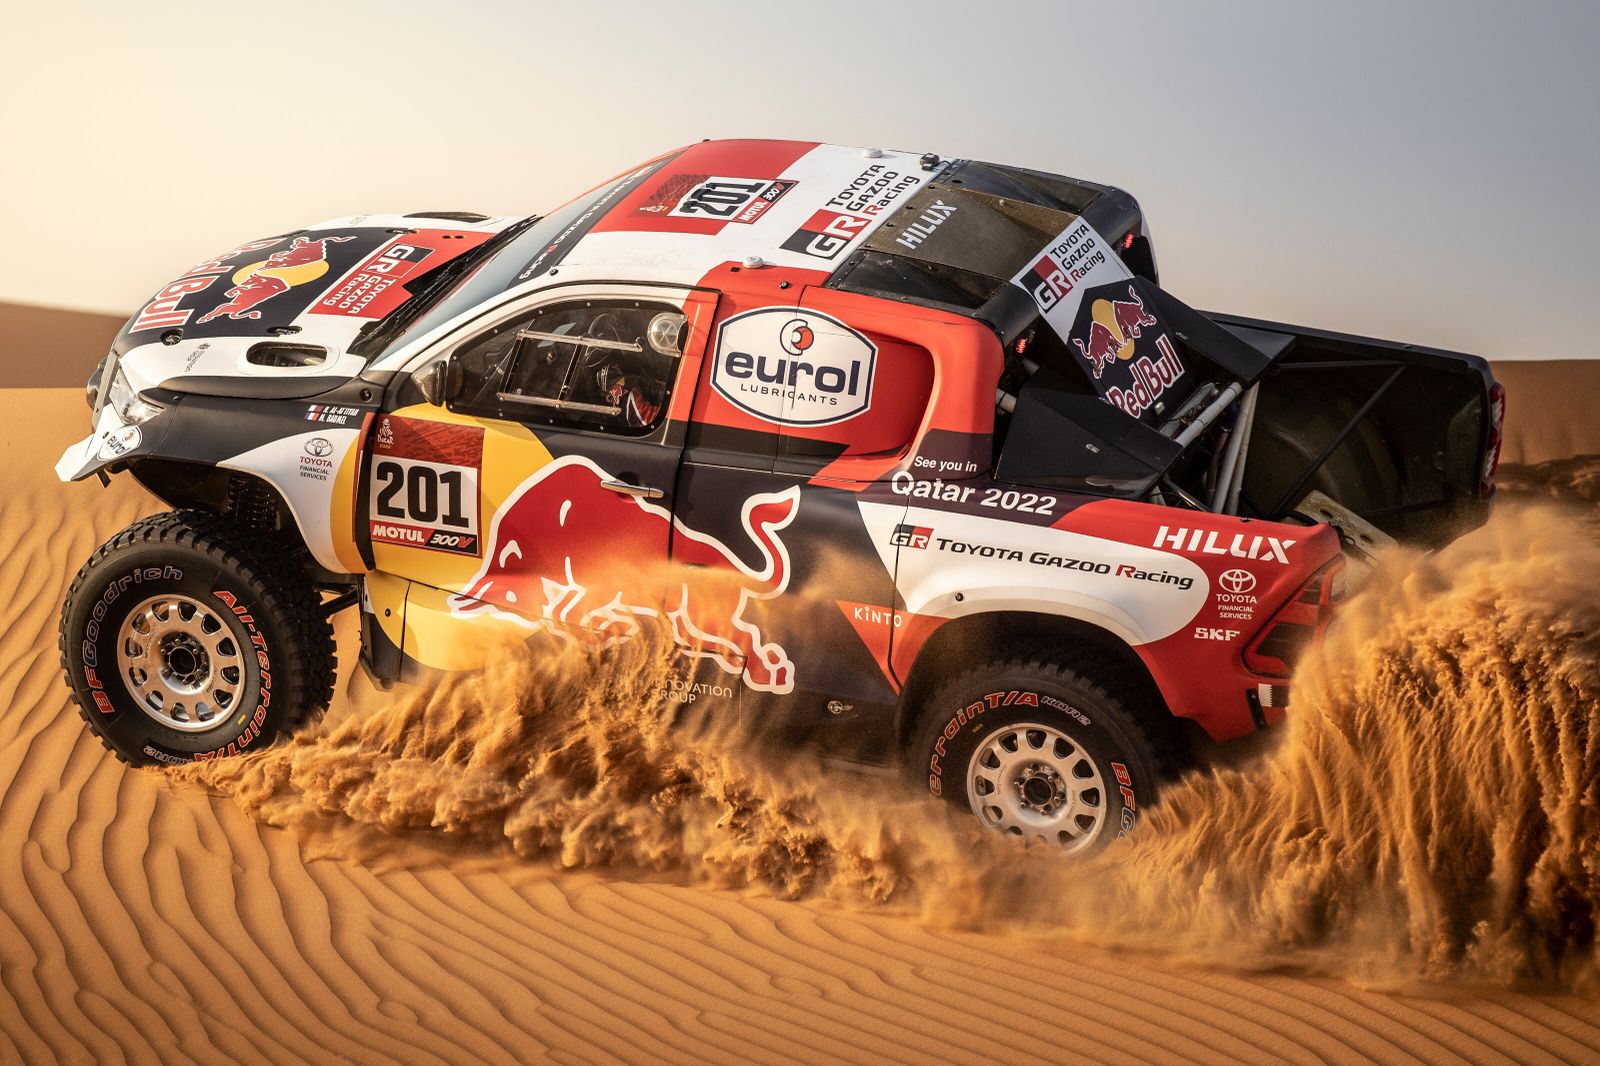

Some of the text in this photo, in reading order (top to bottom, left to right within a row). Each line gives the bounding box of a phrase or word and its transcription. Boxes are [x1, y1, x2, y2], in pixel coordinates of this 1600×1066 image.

[679, 182, 767, 217] 201
[738, 183, 786, 222] MOTUL 300V
[826, 164, 886, 207] TOYOTA
[846, 171, 899, 212] GAZOO
[863, 175, 920, 216] Racing
[805, 215, 868, 258] GR
[896, 199, 957, 250] HILUX
[1050, 224, 1090, 259] TOYOTA
[366, 244, 415, 273] GR
[1061, 238, 1096, 271] GAZOO
[1070, 249, 1106, 283] Racing
[322, 273, 370, 306] Racing
[338, 275, 382, 309] GAZOO
[348, 279, 397, 314] TOYOTA
[1034, 269, 1071, 311] GR
[725, 350, 861, 397] eurol
[740, 383, 838, 406] LUBRICANTS
[300, 456, 333, 468] TOYOTA
[300, 465, 330, 475] FINANCIAL
[300, 472, 327, 481] SERVICES
[914, 456, 978, 473] See you in
[376, 461, 470, 529] 201
[891, 470, 1057, 516] Qatar 2022
[372, 524, 475, 549] MOTUL 300V
[1152, 525, 1297, 565] HILUX
[890, 532, 1194, 591] GR TOYOTA GAZOO Racing
[1216, 594, 1258, 605] TOYOTA
[1217, 605, 1255, 613] FINANCIAL
[1219, 611, 1252, 620] SERVICES
[82, 565, 183, 714] BFGoodrich
[1194, 627, 1241, 641] SKF
[213, 590, 272, 749] All-Terrain
[652, 689, 697, 704] ROUP
[984, 690, 1039, 708] T/A
